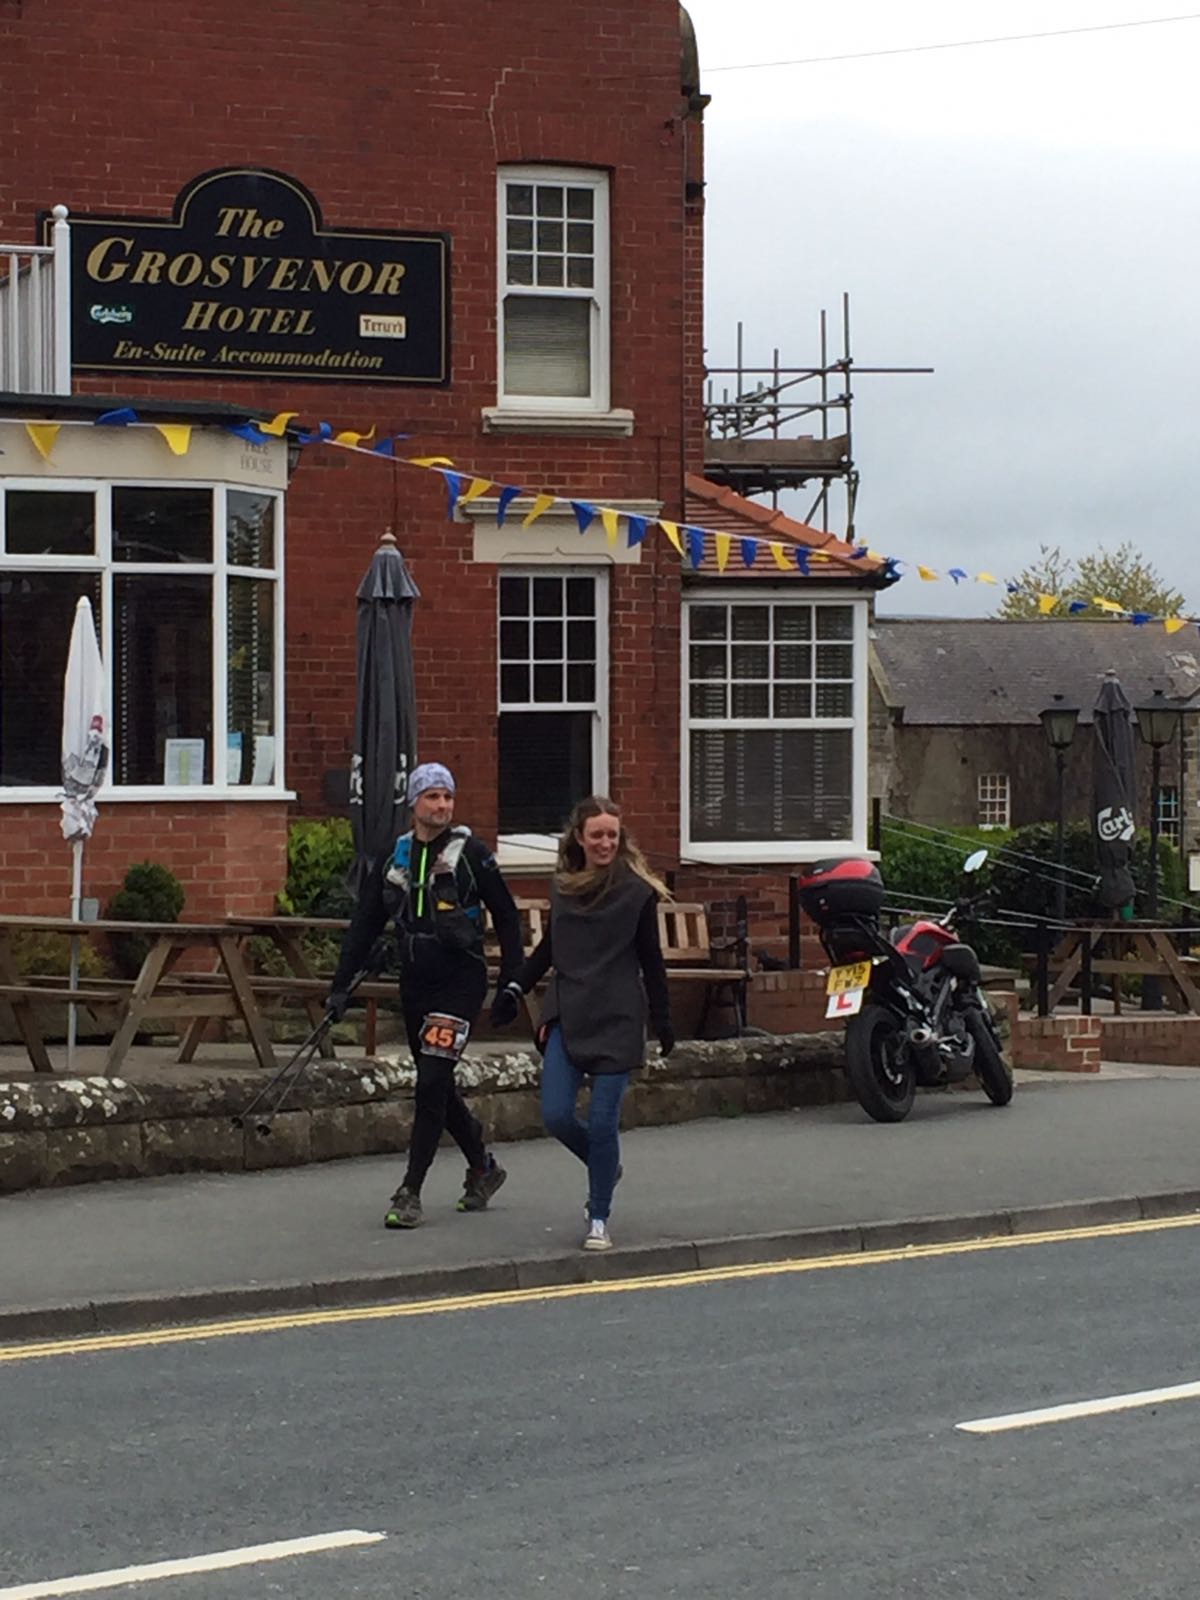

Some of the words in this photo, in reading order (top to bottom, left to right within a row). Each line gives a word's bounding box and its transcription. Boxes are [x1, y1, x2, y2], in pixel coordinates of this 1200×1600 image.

[215, 207, 285, 239] The
[86, 236, 406, 295] GROSVENOR
[182, 302, 316, 335] HOTEL
[113, 341, 206, 362] En-Suite
[212, 344, 384, 369] Accommodation
[425, 1026, 454, 1048] 45
